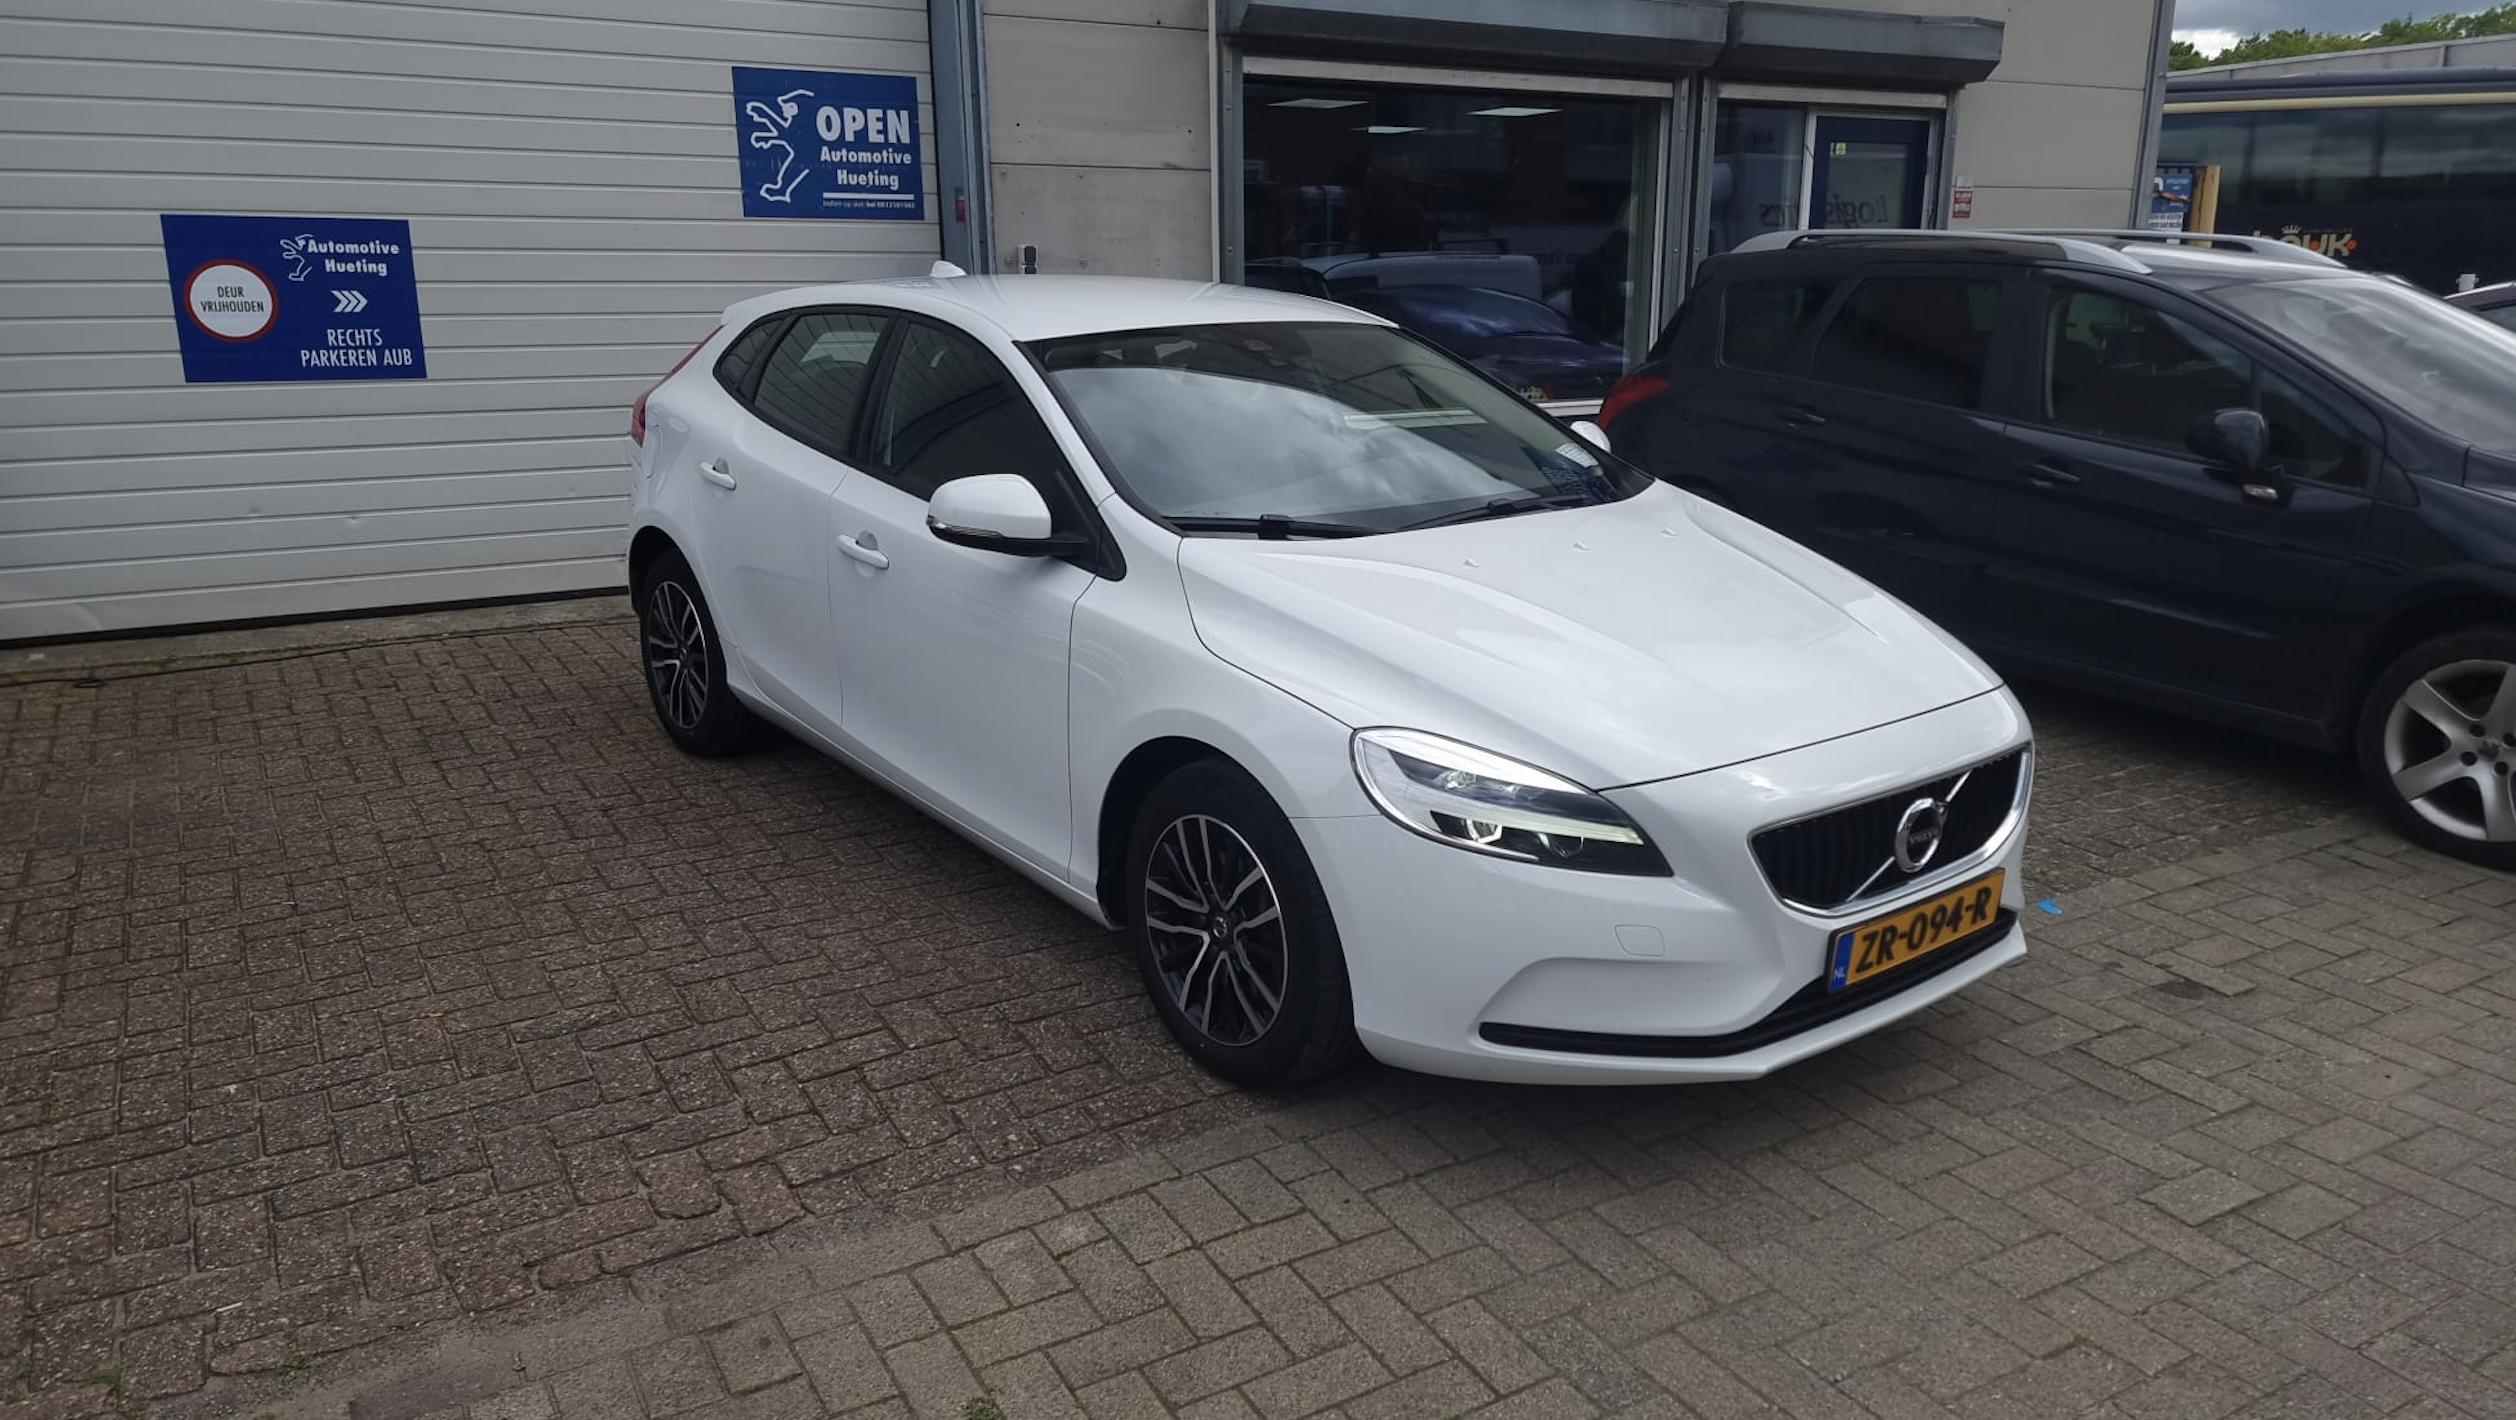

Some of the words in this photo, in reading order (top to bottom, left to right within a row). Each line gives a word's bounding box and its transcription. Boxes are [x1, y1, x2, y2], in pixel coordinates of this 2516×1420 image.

[816, 106, 911, 144] OPEN
[820, 146, 912, 165] Automotive
[837, 169, 899, 190] Hueting
[308, 239, 400, 255] Automotive
[325, 259, 388, 277] Hueting
[217, 286, 245, 298] DEUR
[200, 300, 265, 313] VRIJHOUDEN
[327, 328, 383, 347] RECHTS
[301, 349, 377, 368] PARKEREN
[383, 348, 413, 367] AUB
[1855, 887, 1992, 974] ZR-094-R
[1834, 968, 1846, 979] NL
